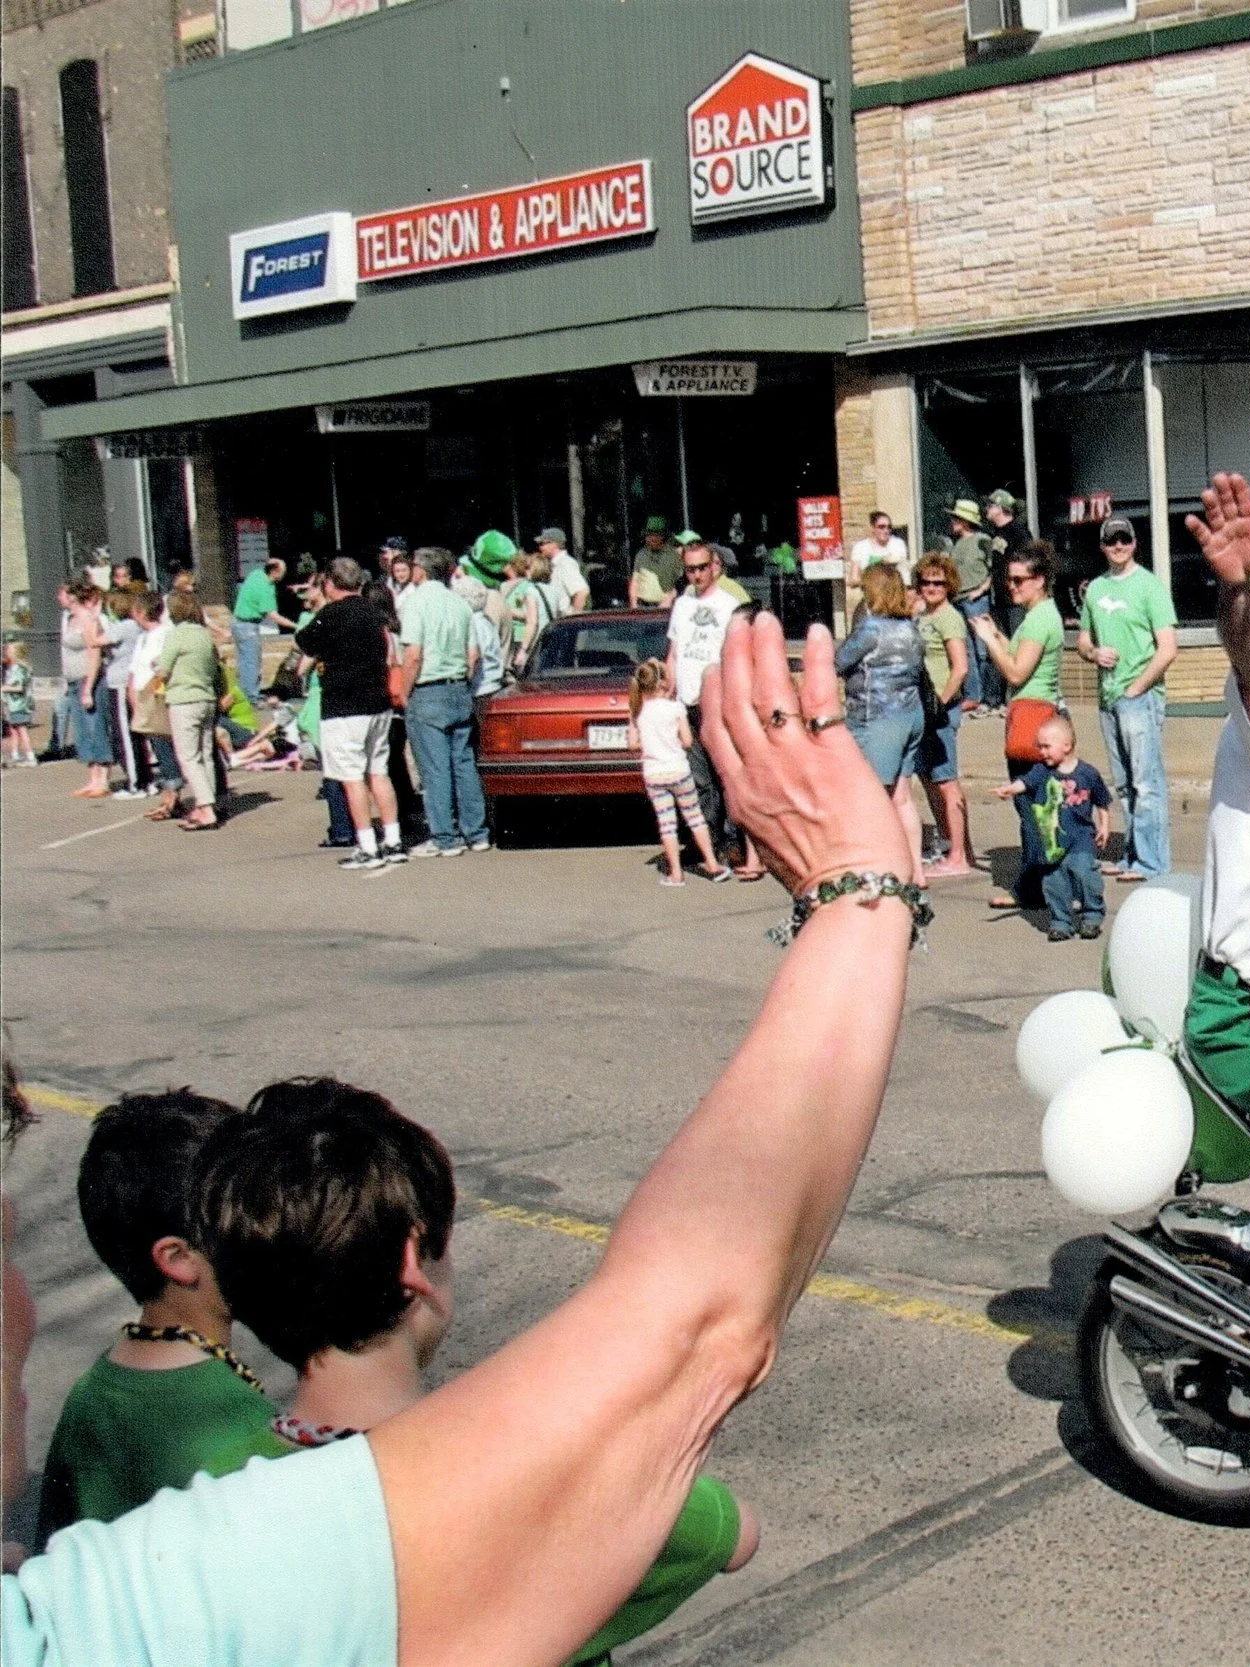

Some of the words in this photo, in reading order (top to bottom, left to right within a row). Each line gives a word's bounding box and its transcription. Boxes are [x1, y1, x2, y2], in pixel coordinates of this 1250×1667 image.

[693, 97, 808, 153] BRAND
[693, 140, 812, 199] SOURCE
[358, 207, 479, 272] TELEVISION
[489, 204, 505, 250] &
[515, 173, 642, 243] APPLIANCE
[247, 249, 324, 293] FOREST
[651, 379, 661, 392] &
[665, 379, 749, 392] APPLIANCE
[659, 364, 719, 378] FOREST
